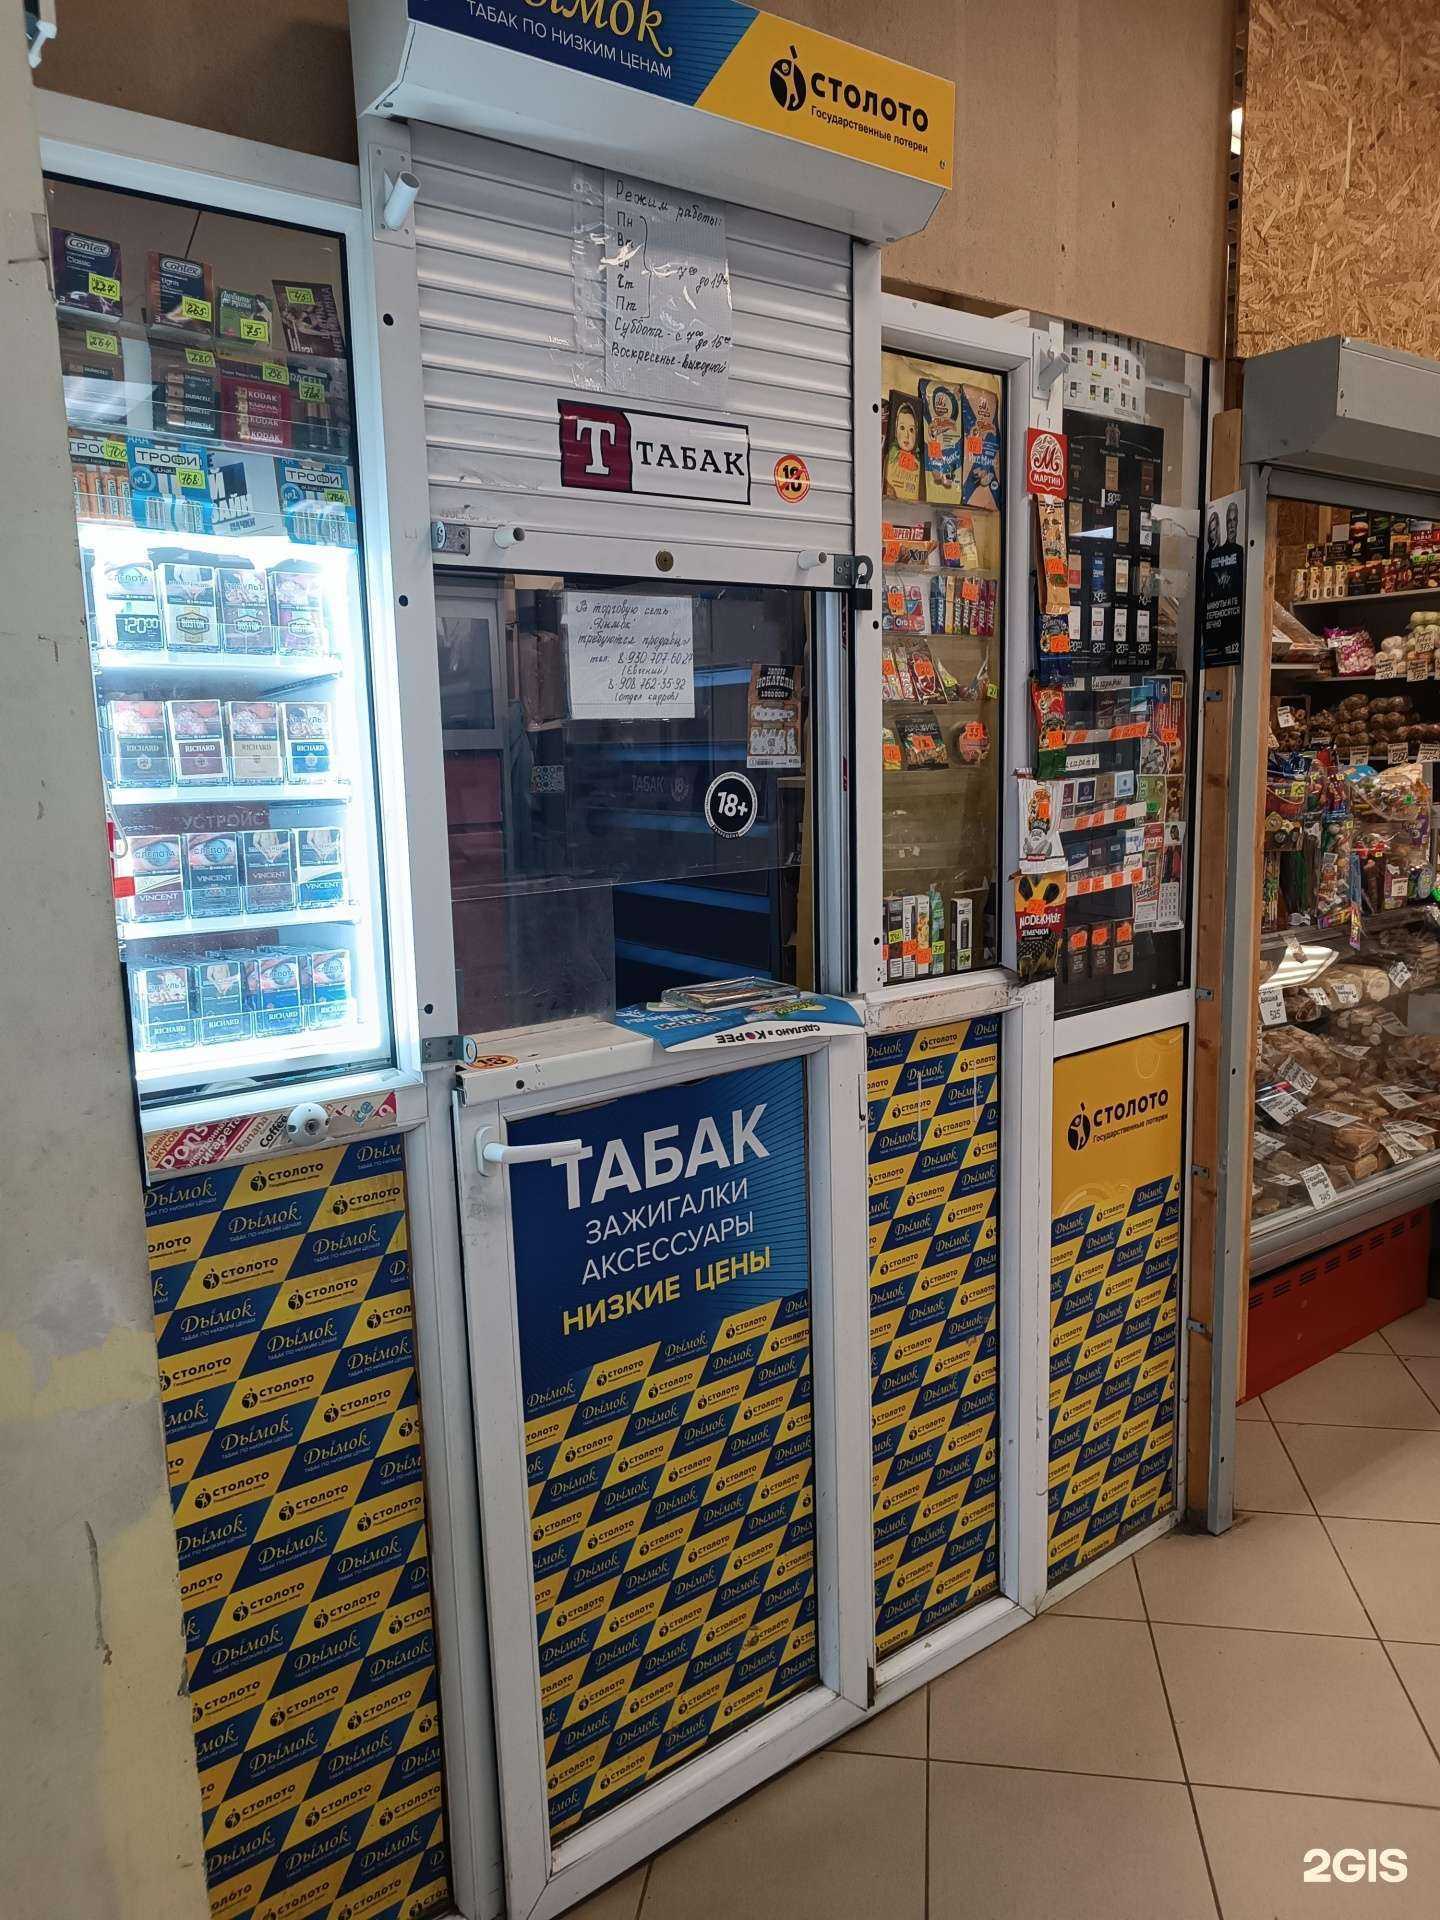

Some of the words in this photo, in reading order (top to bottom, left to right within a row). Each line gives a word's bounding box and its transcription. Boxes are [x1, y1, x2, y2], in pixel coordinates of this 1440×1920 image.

[467, 0, 518, 30] ТАБАК
[523, 19, 547, 38] ПО
[552, 29, 616, 61] НИЗКИМ
[621, 50, 671, 79] ЦЕНАМ
[811, 73, 928, 132] СТОЛОТО
[811, 106, 891, 141] Государственные
[894, 136, 928, 153] лотереи
[616, 180, 668, 211] Режим
[617, 212, 633, 227] Пн
[69, 238, 109, 255] Contex
[66, 257, 91, 267] Classic
[162, 259, 201, 276] Contex
[617, 275, 634, 289] Чт
[616, 296, 637, 310] Пт
[615, 317, 663, 339] Суббота
[248, 391, 279, 402] KODAK
[251, 431, 282, 443] KODAK
[576, 418, 616, 475] Т
[636, 440, 745, 476] ТАБАК
[137, 450, 198, 467] ТРОФИ
[288, 470, 341, 485] ТРОФИ
[1033, 473, 1062, 486] МАРТИН
[185, 744, 215, 753] RICHARD
[296, 744, 325, 752] RICHARD
[717, 791, 749, 817] 18+
[196, 874, 233, 883] VINCENT
[252, 871, 287, 880] VINCENT
[305, 881, 341, 890] VINCENT
[139, 892, 179, 902] VINCENT
[208, 1018, 240, 1028] RICHARD
[268, 1012, 298, 1021] RICHARD
[154, 1025, 186, 1035] RICHARD
[775, 1024, 821, 1037] СДЕЛАНО
[928, 1032, 957, 1047] СТОЛОТО
[907, 1061, 944, 1081] Дымок
[1093, 1089, 1168, 1127] СТОЛОТО
[235, 1115, 269, 1154] Banana
[942, 1119, 971, 1134] СТОЛОТО
[1092, 1120, 1145, 1144] Государственные
[551, 1103, 770, 1210] ТАБАК
[922, 1147, 958, 1168] Дымок
[268, 1162, 324, 1182] СТОЛОТО
[144, 1178, 216, 1209] Дымок
[349, 1186, 400, 1206] СТОЛОТО
[1137, 1185, 1163, 1202] Дымок
[229, 1202, 302, 1234] Дымок
[585, 1177, 748, 1245] ЗАЖИГАЛКИ
[1103, 1203, 1125, 1217] СТОЛОТО
[1056, 1215, 1084, 1234] Дымок
[148, 1236, 191, 1253] ОЛОТО
[313, 1223, 380, 1256] Дымок
[582, 1211, 753, 1285] АКСЕССУАРЫ
[220, 1257, 279, 1278] СТОЛОТО
[304, 1278, 358, 1299] СТОЛОТО
[563, 1275, 680, 1336] НИЗКИЕ
[695, 1246, 771, 1291] ЦЕНЫ
[180, 1300, 256, 1334] Дымок
[735, 1314, 766, 1331] СТОЛОТО
[348, 1336, 411, 1370] Дымок
[665, 1331, 707, 1357] Дымок
[172, 1356, 231, 1380] СТОЛОТО
[608, 1359, 643, 1378] СТОЛОТО
[713, 1345, 754, 1370] Дымок
[259, 1374, 314, 1397] СТОЛОТО
[658, 1372, 693, 1390] СТОЛОТО
[340, 1389, 390, 1412] СТОЛОТО
[527, 1378, 576, 1408] Дымок
[582, 1392, 629, 1419] Дымок
[221, 1414, 293, 1452] Дымок
[304, 1428, 370, 1466] Дымок
[212, 1471, 269, 1497] СТОЛОТО
[296, 1484, 348, 1509] СТОЛОТО
[259, 1525, 327, 1564] Дымок
[568, 1595, 604, 1618] СТОЛОТО
[212, 1625, 283, 1667] Дымок
[294, 1630, 360, 1670] Дымок
[596, 1634, 640, 1667] Дымок
[204, 1680, 260, 1710] СТОЛОТО
[286, 1685, 339, 1714] СТОЛОТО
[250, 1727, 318, 1772] Дымок
[242, 1783, 296, 1816] СТОЛОТО
